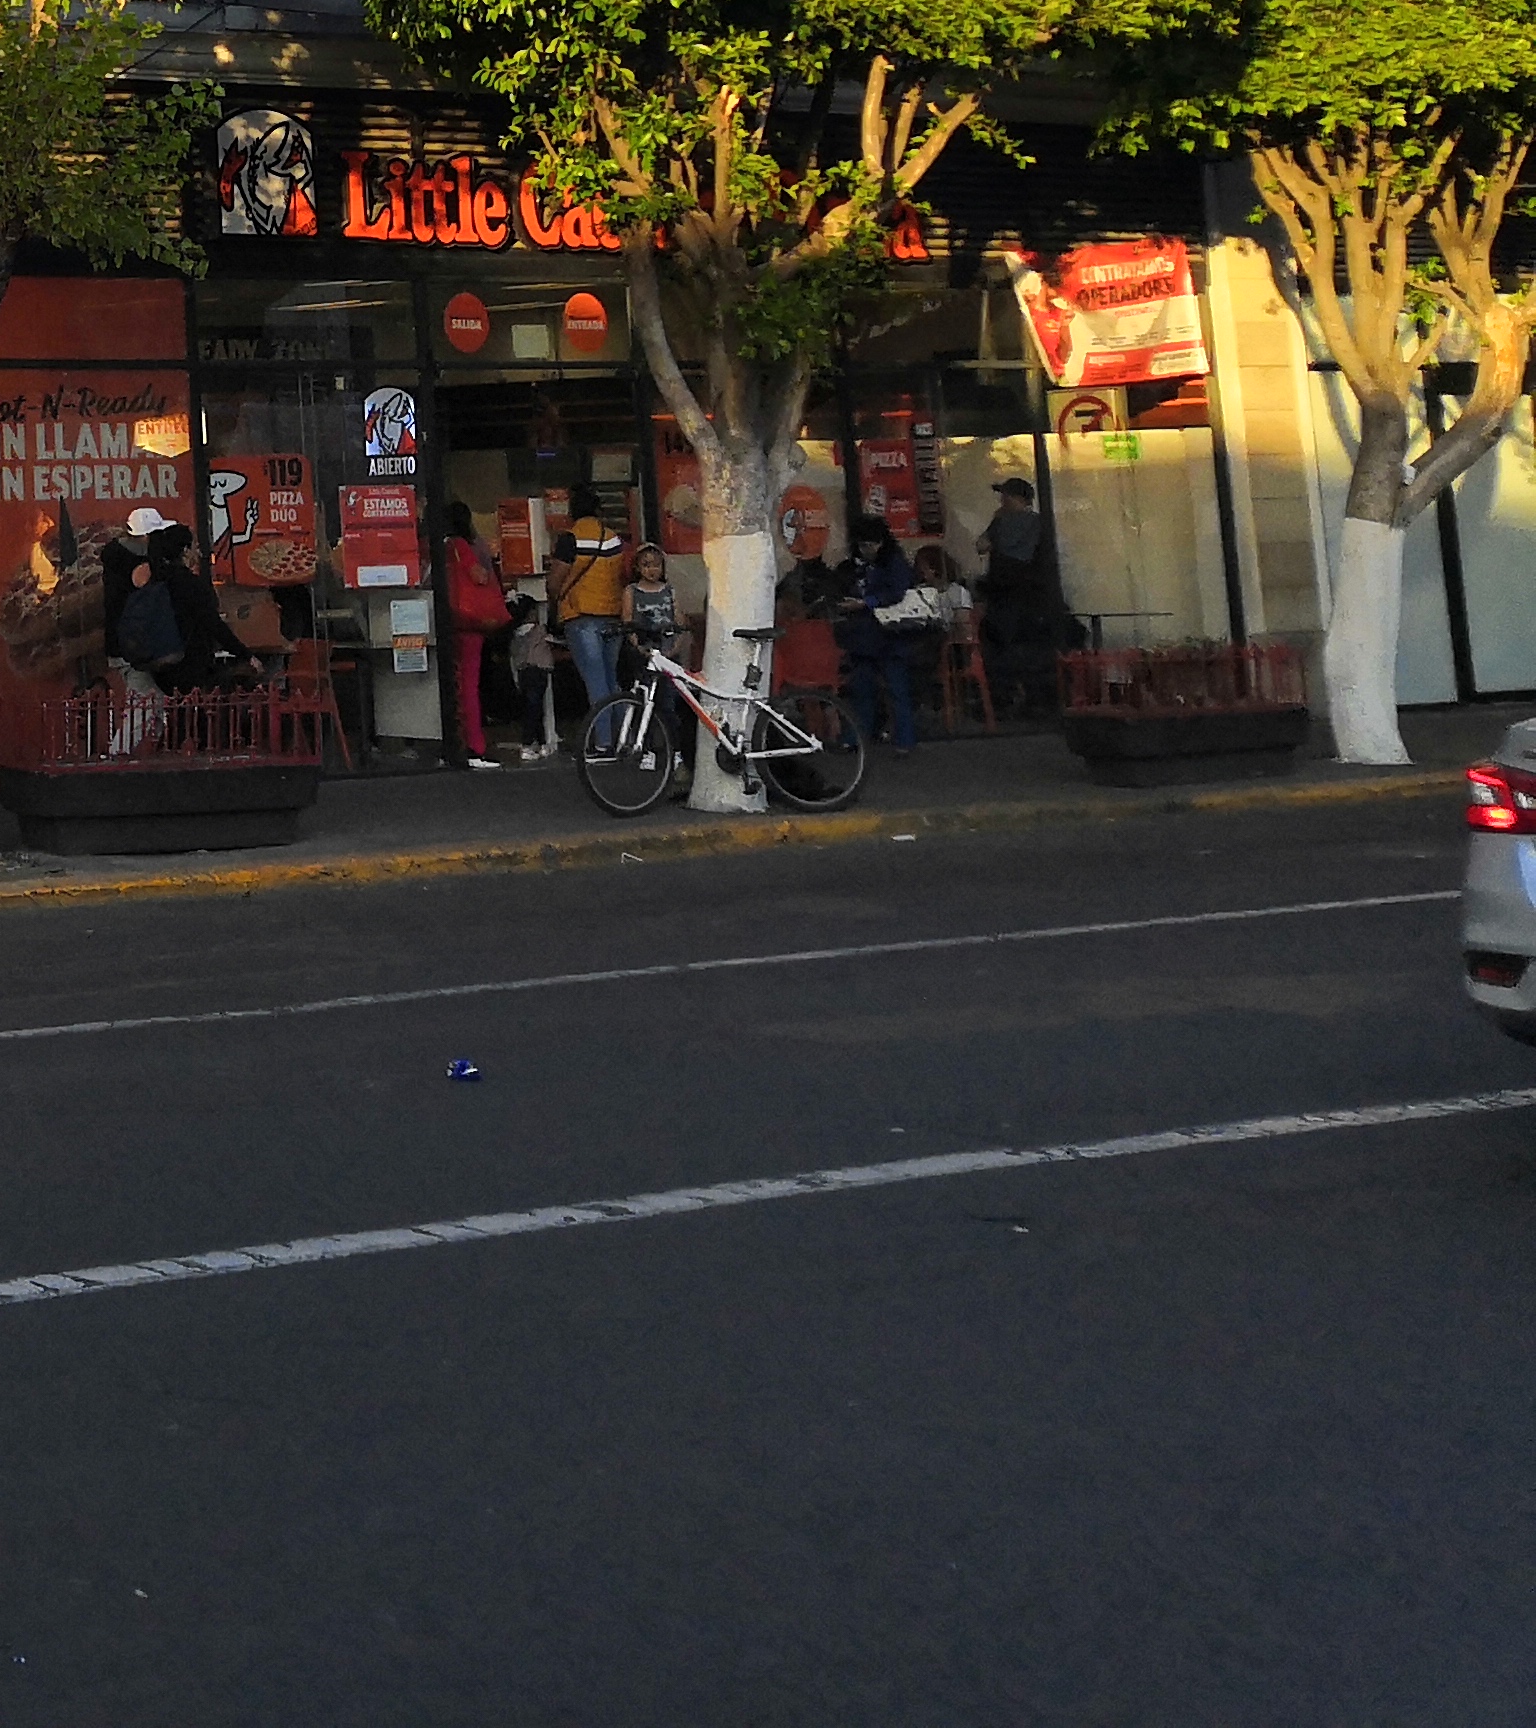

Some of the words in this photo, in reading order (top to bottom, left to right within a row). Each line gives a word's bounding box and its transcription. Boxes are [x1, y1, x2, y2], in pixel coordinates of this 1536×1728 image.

[340, 150, 509, 249] Little
[451, 318, 483, 331] SALIDA
[368, 456, 416, 477] ABIERTO
[34, 463, 179, 501] ESPERAR
[269, 491, 305, 506] PIZZA
[363, 497, 408, 510] ESTAMOS
[270, 508, 298, 523] DUO
